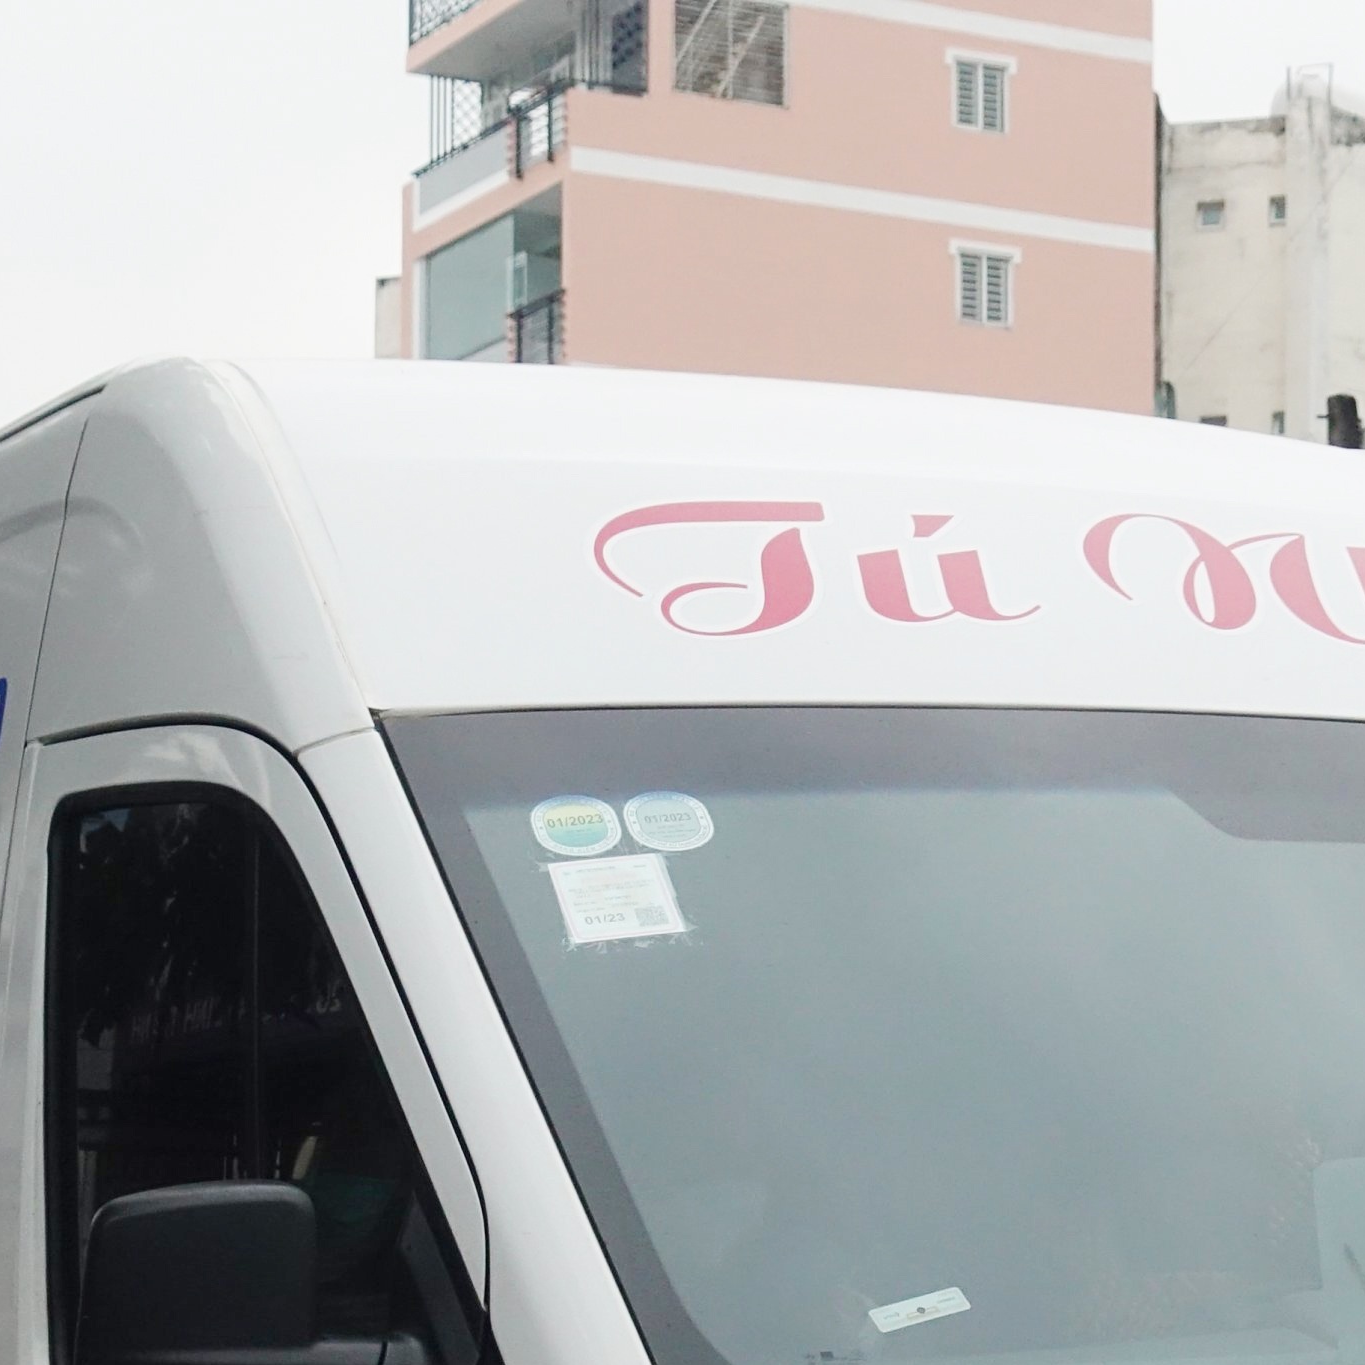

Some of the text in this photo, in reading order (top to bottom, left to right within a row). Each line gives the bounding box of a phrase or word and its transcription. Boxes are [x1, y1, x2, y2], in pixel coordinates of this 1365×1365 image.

[546, 813, 604, 829] 01/2023
[643, 812, 692, 825] 01/2023
[584, 912, 626, 926] 01/23
